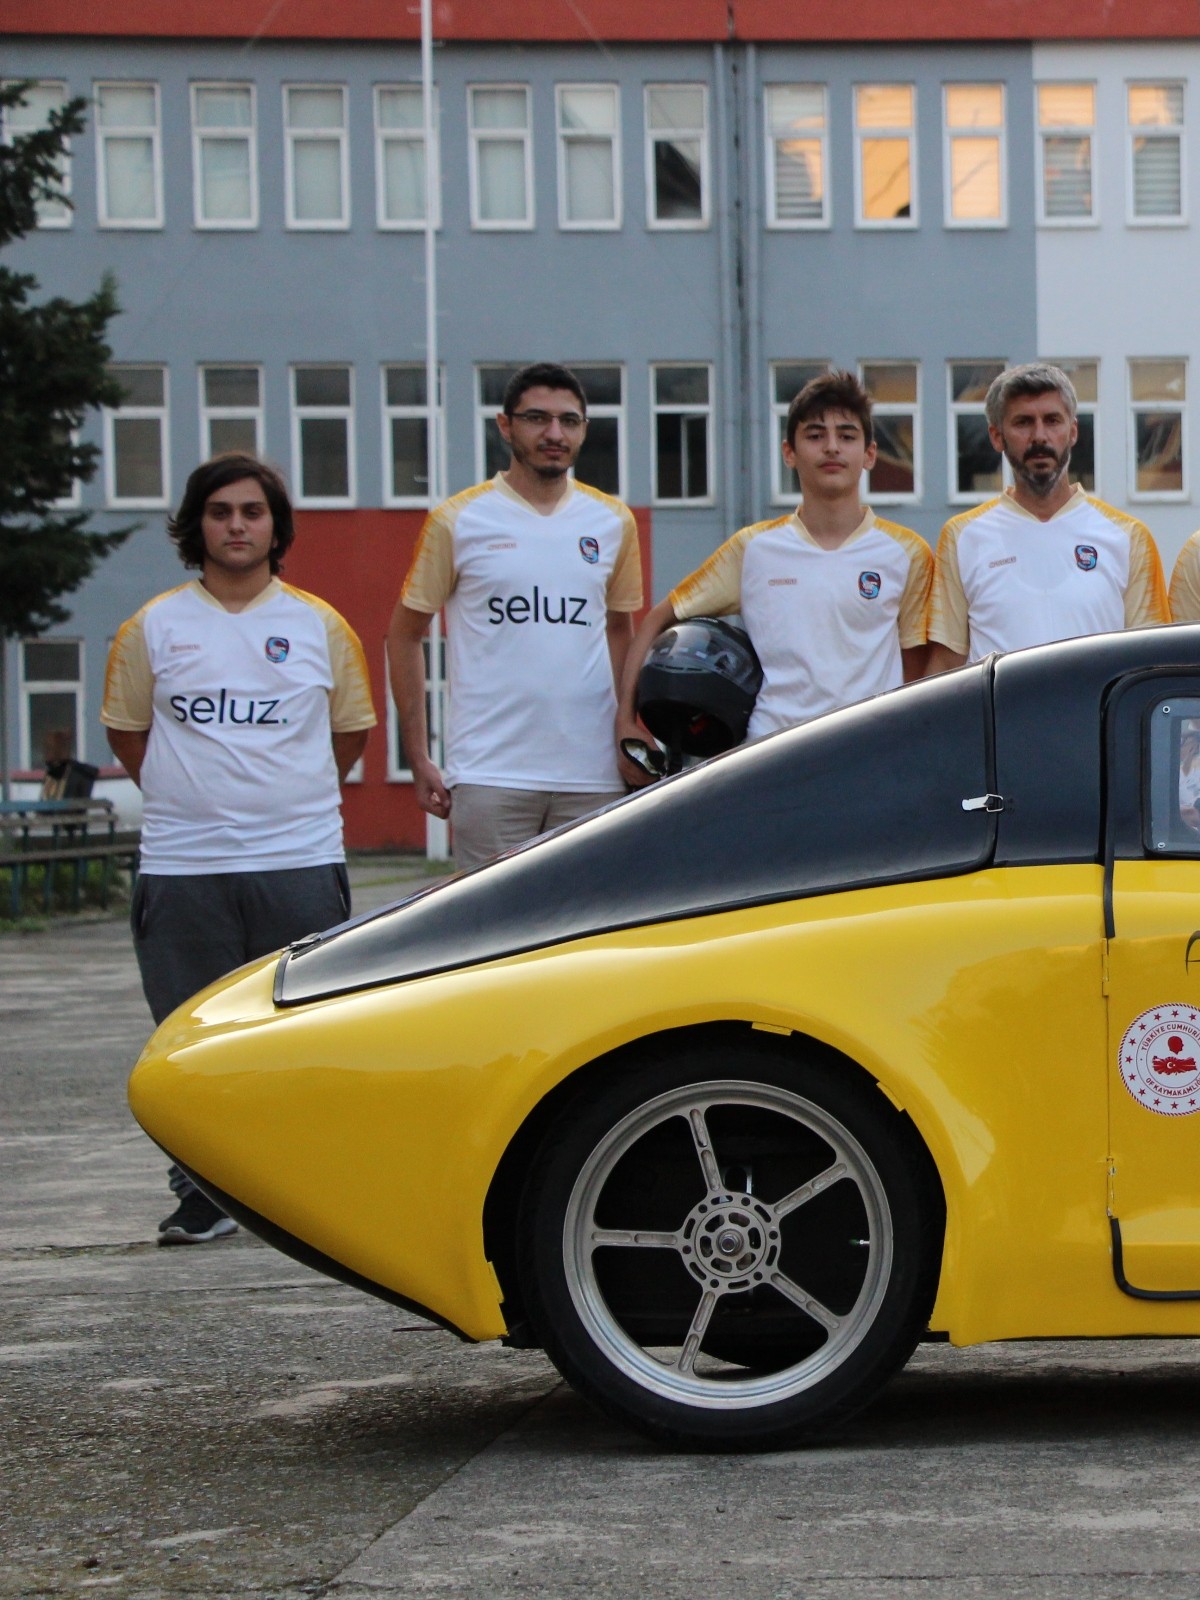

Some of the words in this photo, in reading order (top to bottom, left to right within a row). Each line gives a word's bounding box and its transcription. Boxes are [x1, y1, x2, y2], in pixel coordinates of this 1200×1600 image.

[488, 586, 592, 627] seluz.
[170, 688, 288, 724] seluz.
[1145, 1077, 1155, 1087] OF
